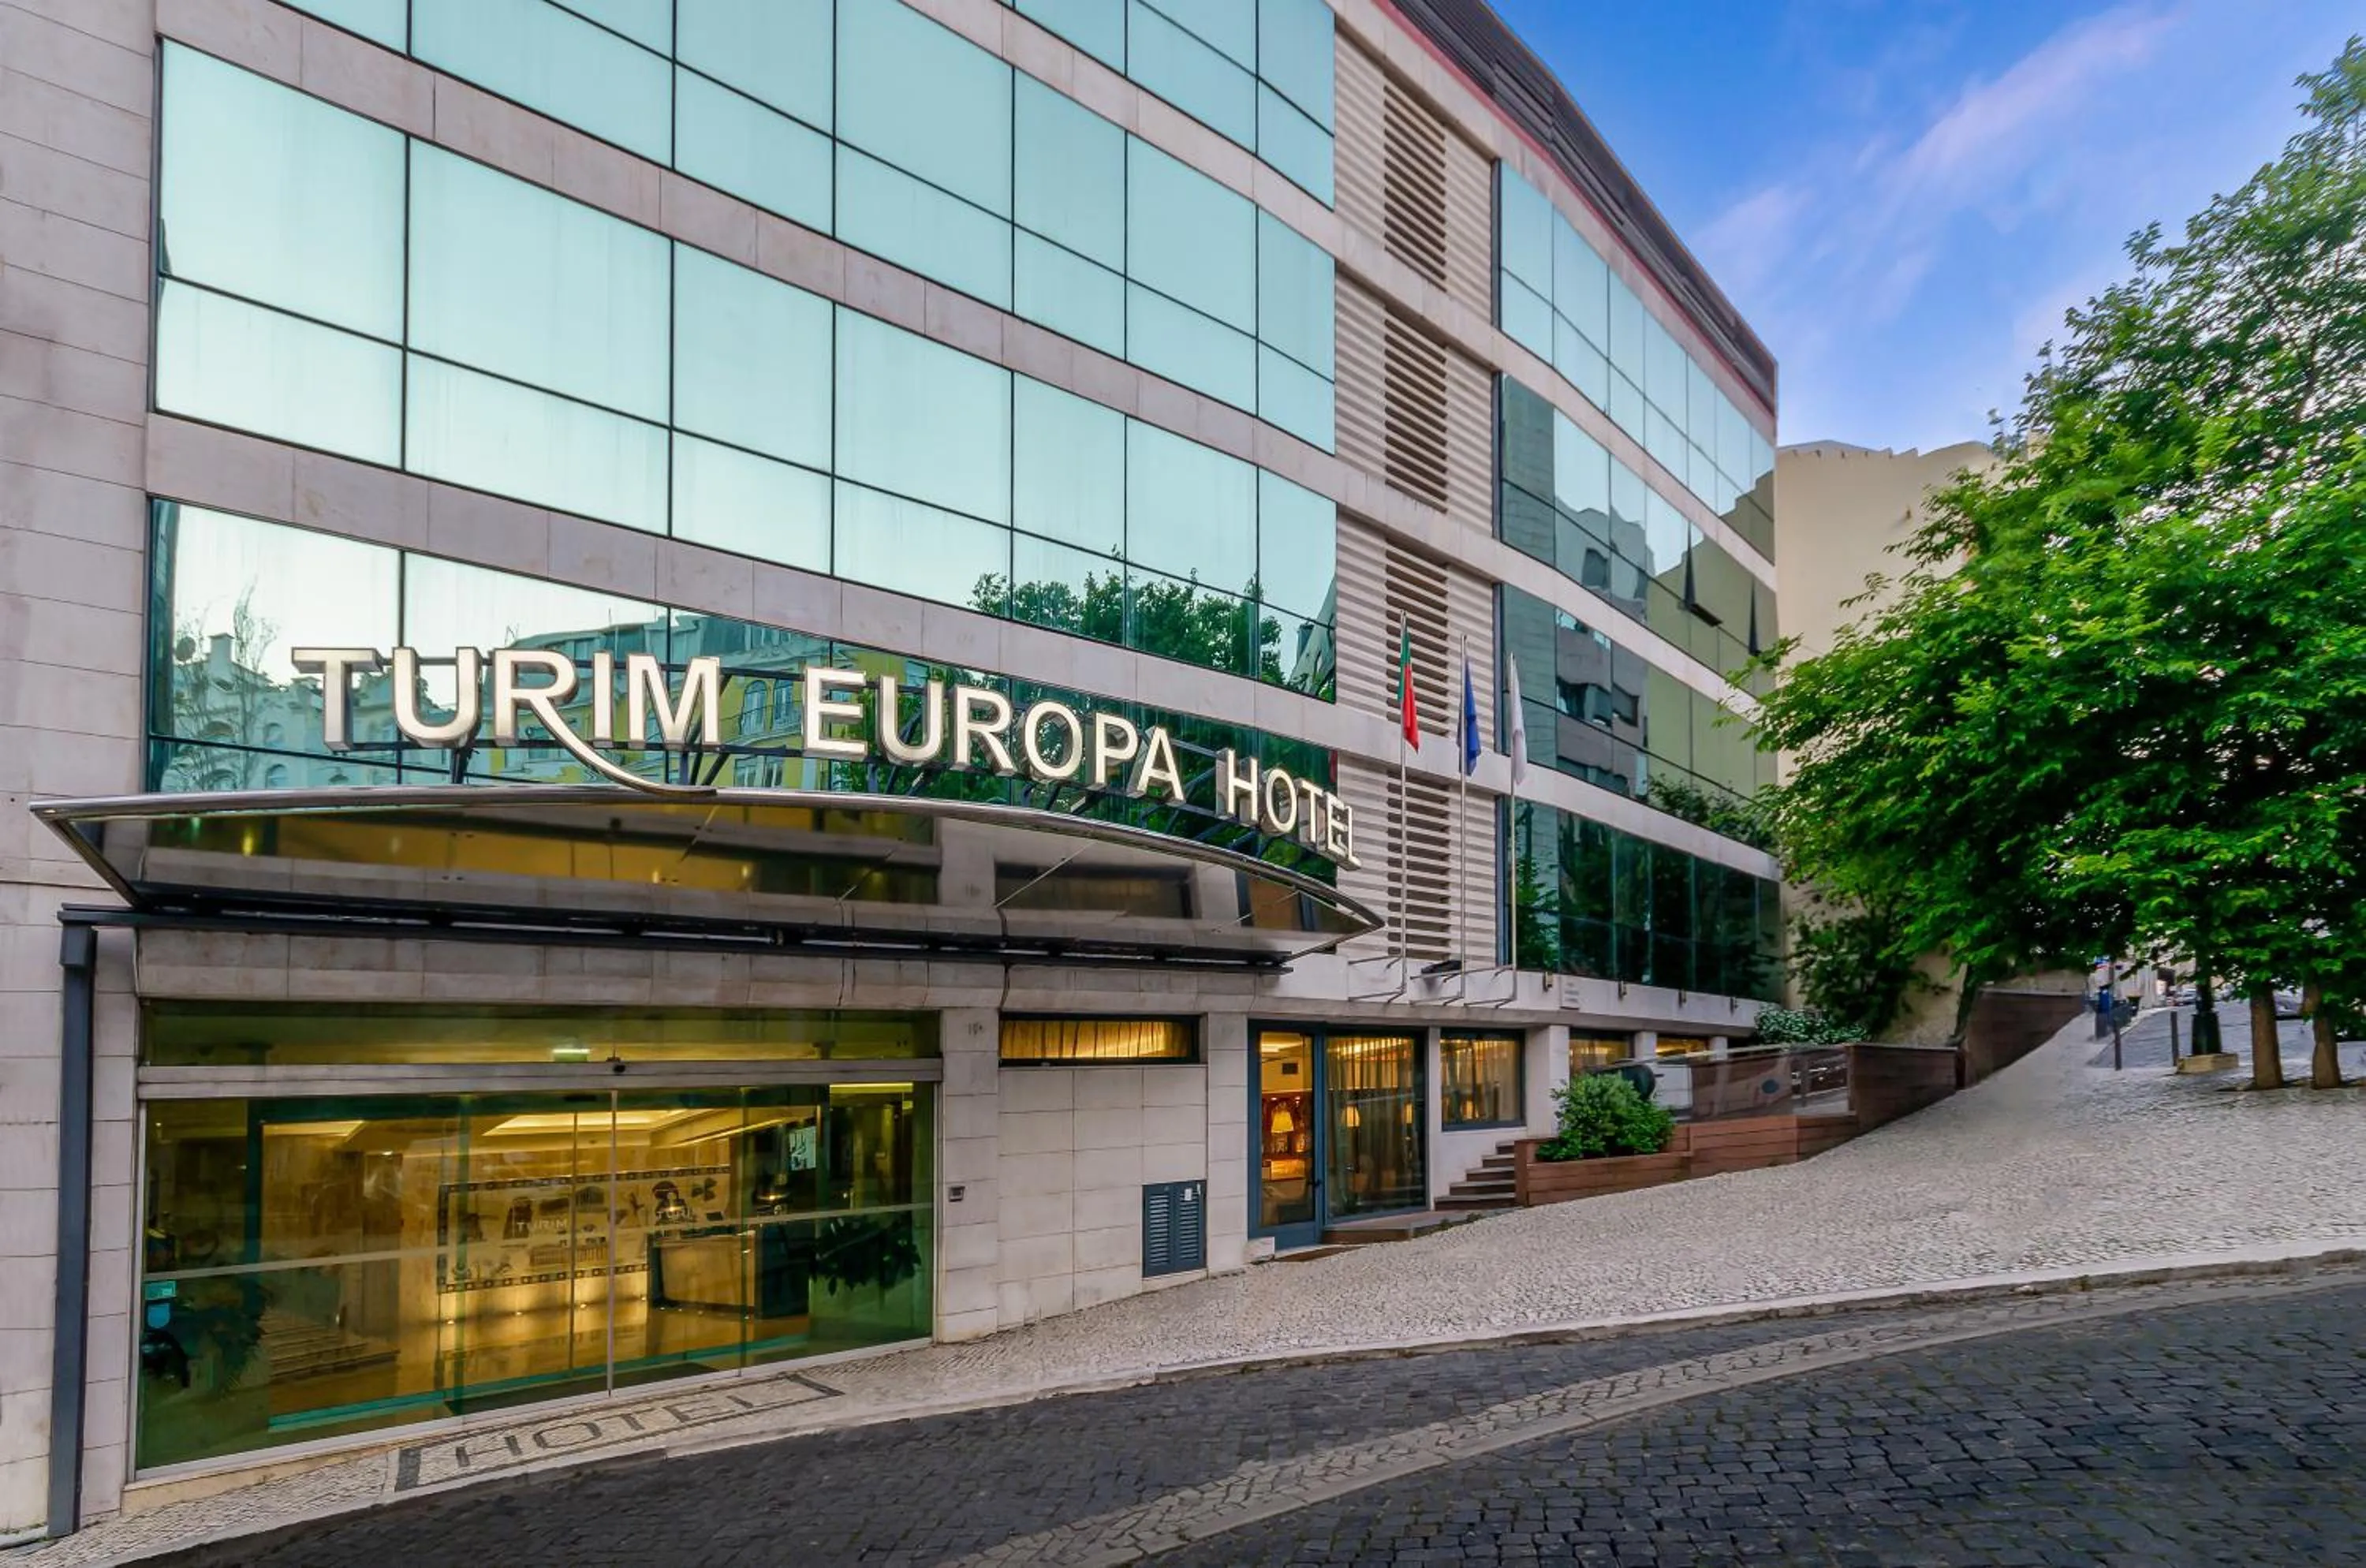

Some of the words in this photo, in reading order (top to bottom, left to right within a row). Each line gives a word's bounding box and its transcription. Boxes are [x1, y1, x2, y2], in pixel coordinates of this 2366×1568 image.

[291, 647, 719, 796] TURIM
[803, 666, 1185, 804] EUROPA
[1215, 748, 1362, 871] HOTEL
[454, 1394, 792, 1468] HOTEL
